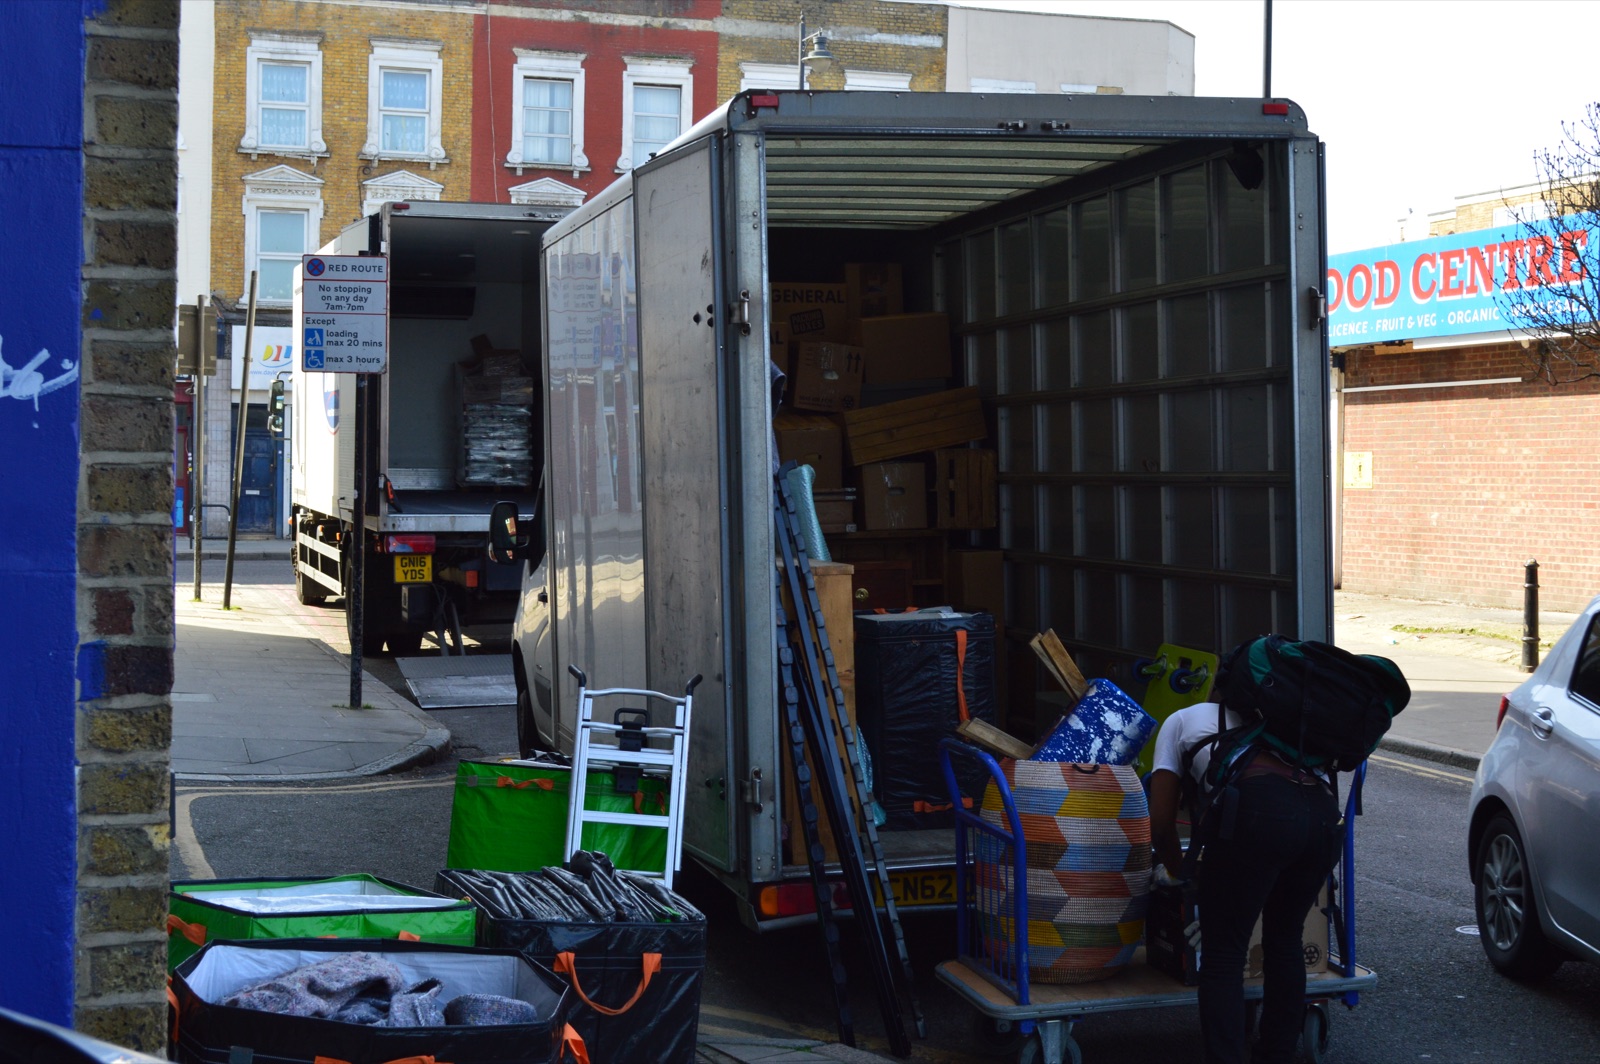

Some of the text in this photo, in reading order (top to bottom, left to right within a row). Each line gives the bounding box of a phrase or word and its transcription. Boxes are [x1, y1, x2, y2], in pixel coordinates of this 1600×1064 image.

[328, 264, 384, 273] RED ROUTE
[1409, 229, 1589, 304] CENTRE
[318, 284, 372, 294] No stopping
[335, 295, 350, 303] any
[353, 294, 369, 303] day
[771, 288, 845, 304] GENERAL
[325, 303, 365, 311] 7am-7pm
[305, 317, 336, 326] Except
[1375, 315, 1405, 332] FRUIT
[1407, 316, 1415, 329] &
[1416, 312, 1437, 328] VEG
[1447, 306, 1500, 325] ORGANIC
[326, 330, 359, 339] loading
[347, 339, 360, 347] 20
[362, 340, 383, 348] mins
[346, 355, 353, 363] 3
[355, 355, 381, 364] hours
[400, 556, 427, 568] GN16
[402, 568, 425, 580] YDS
